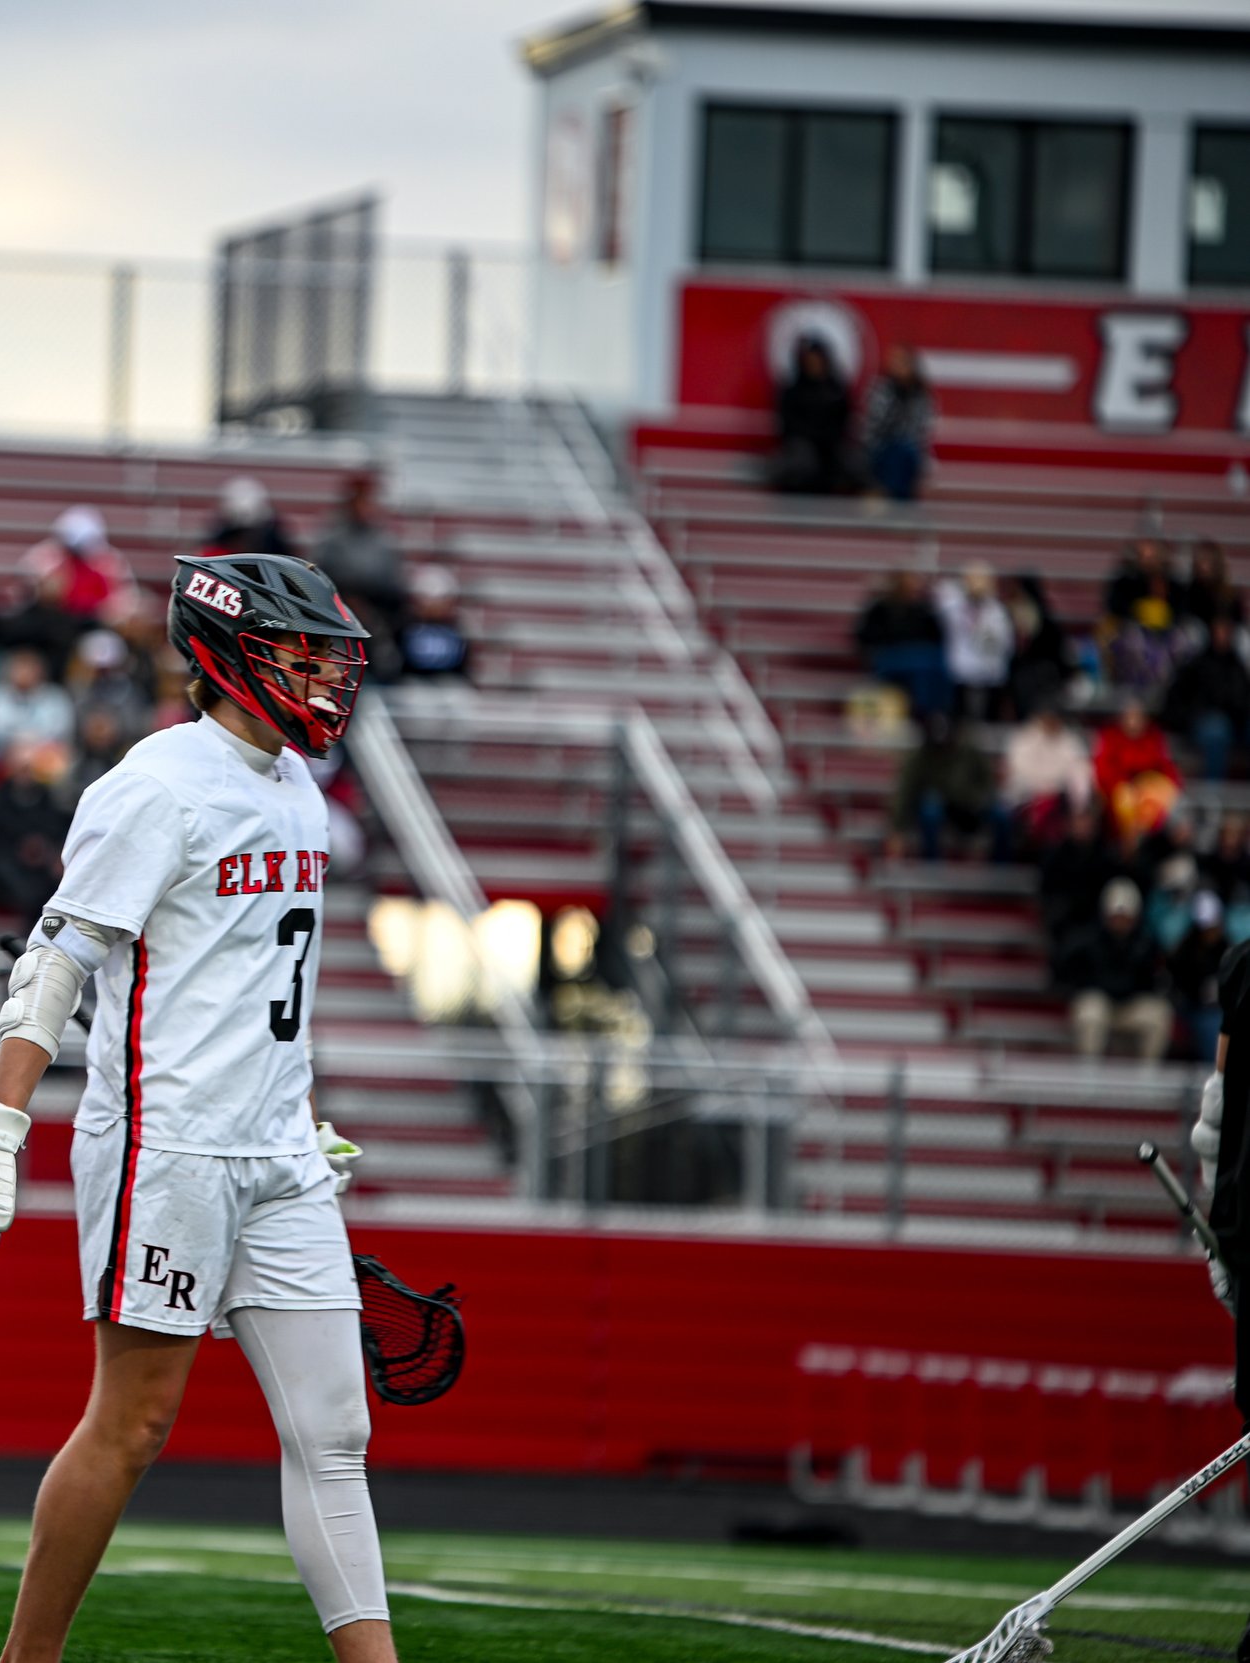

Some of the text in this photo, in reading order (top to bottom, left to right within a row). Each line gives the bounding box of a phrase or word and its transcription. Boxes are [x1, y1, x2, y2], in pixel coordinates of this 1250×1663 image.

[184, 571, 244, 618] ELKS
[216, 850, 287, 897] ELK
[270, 907, 316, 1042] 3
[137, 1243, 198, 1312] ER
